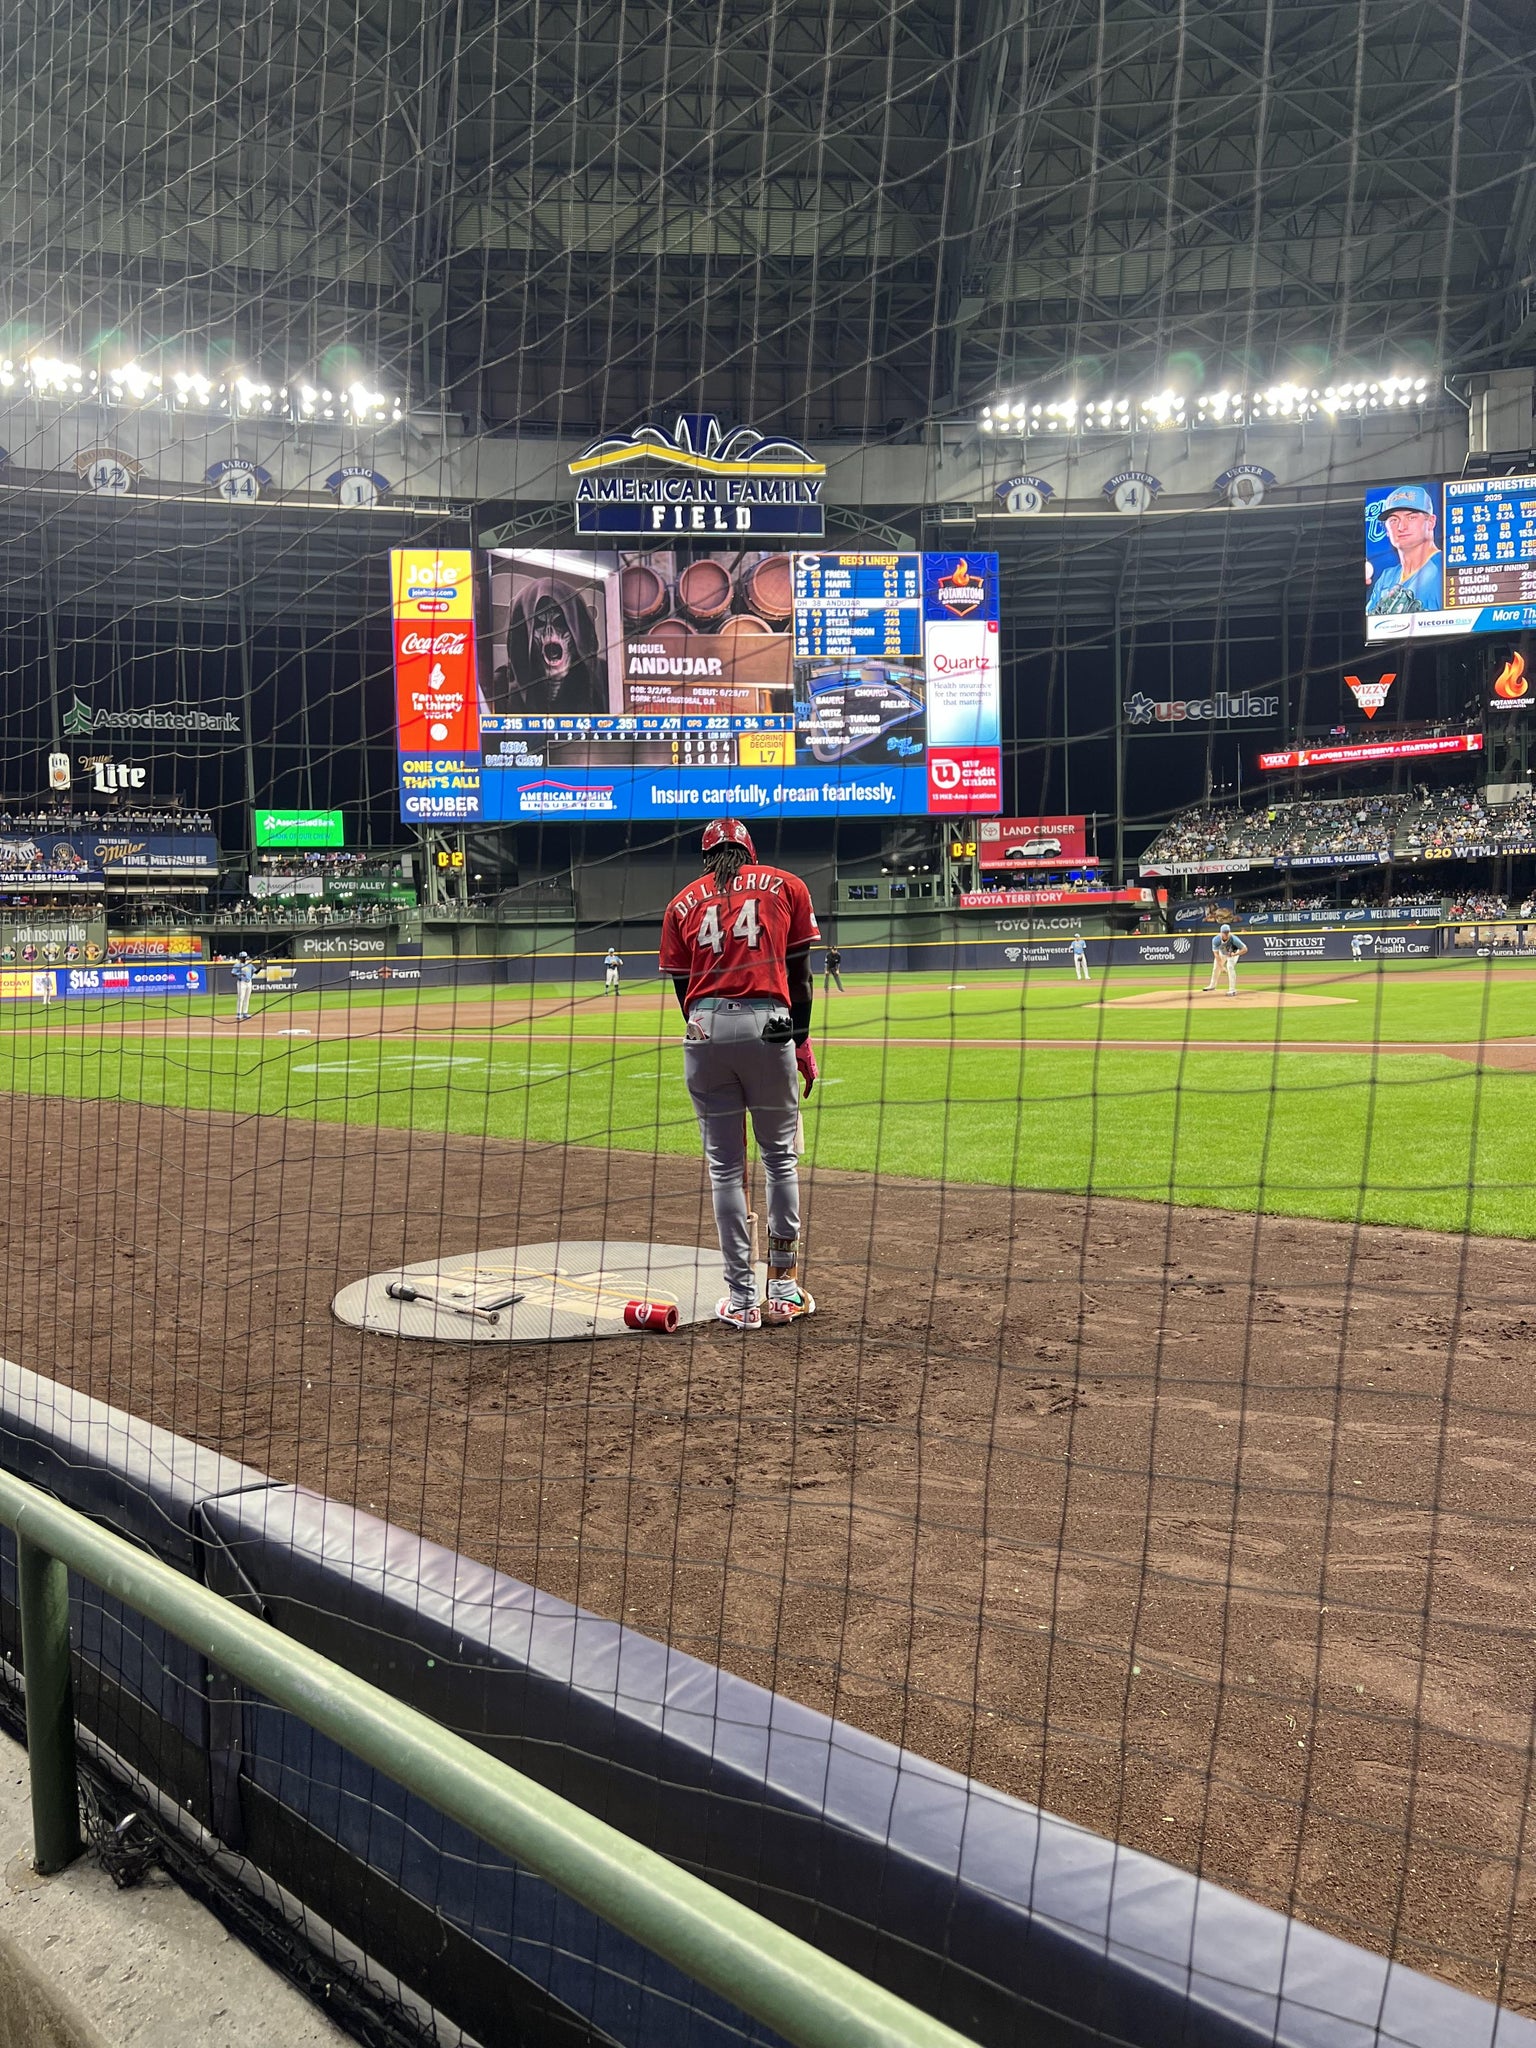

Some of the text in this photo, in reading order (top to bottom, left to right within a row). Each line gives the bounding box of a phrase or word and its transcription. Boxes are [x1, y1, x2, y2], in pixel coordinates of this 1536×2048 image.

[221, 460, 256, 472] AARON
[1226, 466, 1263, 477] UECKER
[94, 466, 126, 489] 42
[342, 468, 373, 478] SELIG
[1110, 471, 1154, 486] MOLITOR
[1008, 476, 1040, 487] YOUNT
[1449, 478, 1536, 496] QUINN PRIESTER
[224, 478, 255, 498] 44
[576, 478, 822, 504] AMERICAN FAMILY
[1012, 492, 1037, 511] 19
[1125, 488, 1138, 507] 4
[1484, 494, 1502, 502] 2025
[652, 506, 751, 529] FIELD
[1452, 513, 1491, 524] 29 13-2
[1473, 530, 1511, 541] 128 50
[839, 556, 898, 565] REDS LINEUP
[407, 560, 457, 584] Joie
[1485, 565, 1503, 573] NEXT
[1504, 563, 1529, 571] INNING
[825, 570, 850, 578] FRIEDL
[1458, 574, 1489, 585] YELICH
[825, 580, 851, 588] MARTE
[1458, 584, 1498, 595] CHOURIO
[797, 590, 840, 598] LF LUX
[938, 587, 984, 600] POTAWATOMI
[797, 598, 860, 606] DH ANDUJAR
[1458, 594, 1495, 605] TURANG
[797, 608, 847, 617] SS DE LA
[1493, 610, 1520, 622] More
[826, 628, 875, 636] STEPHENSON
[826, 637, 852, 646] HAYES
[628, 644, 666, 654] MIGUEL
[827, 646, 856, 655] MCLAIN
[629, 657, 722, 676] ANDUJAR
[933, 654, 990, 674] Quartz
[647, 686, 672, 695] 3/2/95
[692, 688, 718, 696] DEBUT:
[959, 690, 991, 698] moments
[1352, 684, 1390, 695] VIZZY
[412, 692, 464, 702] Fan work
[815, 695, 845, 705] BAUERS
[943, 698, 957, 706] that
[1360, 698, 1382, 706] LOFT
[1490, 698, 1535, 707] POTAWATOMI
[425, 702, 462, 712] thirsty
[880, 700, 911, 708] FRELICK
[423, 711, 453, 719] work
[819, 709, 842, 717] ORTIZ
[849, 714, 880, 723] TURANG
[94, 708, 240, 731] AssociatedBank
[501, 718, 759, 729] .315 10 43 .351 .471 .822 34
[849, 726, 881, 734] VAUGHN
[750, 741, 784, 749] DECISION
[806, 736, 850, 745] CONTRERAS
[760, 750, 776, 763] L7
[1311, 751, 1343, 760] FLAVORS
[1363, 748, 1394, 756] DESERVE
[1401, 743, 1438, 752] STARTING
[51, 756, 68, 768] Lite
[1263, 754, 1291, 764] VIZZY
[402, 760, 433, 773] ONE
[962, 767, 996, 777] credit
[93, 762, 146, 794] Lite
[402, 776, 480, 789] THAT'S ALL!
[962, 776, 997, 787] union
[520, 791, 612, 801] AMERICAN FAMILY
[651, 782, 896, 807] Insure carefully, dream fearlessly.
[405, 797, 479, 812] GRUBER
[275, 819, 335, 827] AssociatedBank
[1003, 825, 1075, 836] LAND CRUISER
[94, 843, 146, 864] Miller
[952, 843, 977, 857] 0:12
[1424, 845, 1498, 860] 620 WTMJ
[122, 855, 207, 866] TIME, MILWAUKEE
[438, 851, 463, 867] 0:12
[1291, 857, 1311, 866] GREAT
[1312, 856, 1334, 864] TASTE.
[1334, 855, 1343, 863] 96
[1344, 853, 1378, 862] CALORIES.
[329, 881, 385, 890] POWER ALLEY
[675, 873, 784, 917] DE L CRUZ
[963, 892, 1063, 906] TOYOTA TERRITORY
[1273, 911, 1340, 922] WELCOME DELICIOUS
[1370, 907, 1441, 919] WELCOME DELICIOUS
[697, 898, 763, 956] 44
[995, 918, 1082, 931] TOYOTA.COM
[349, 938, 385, 951] Save
[1263, 937, 1326, 947] WINTRUST
[1374, 935, 1406, 945] Aurora
[107, 940, 164, 956] Surfside
[1022, 946, 1073, 954] Northwestern
[1139, 945, 1169, 954] Johnson
[1264, 949, 1304, 957] WISCONSIN'S
[1374, 943, 1429, 954] Health Care
[1022, 953, 1049, 962] Mutual
[1145, 952, 1175, 961] Controls
[69, 969, 99, 989] $145
[393, 969, 421, 979] Farm
